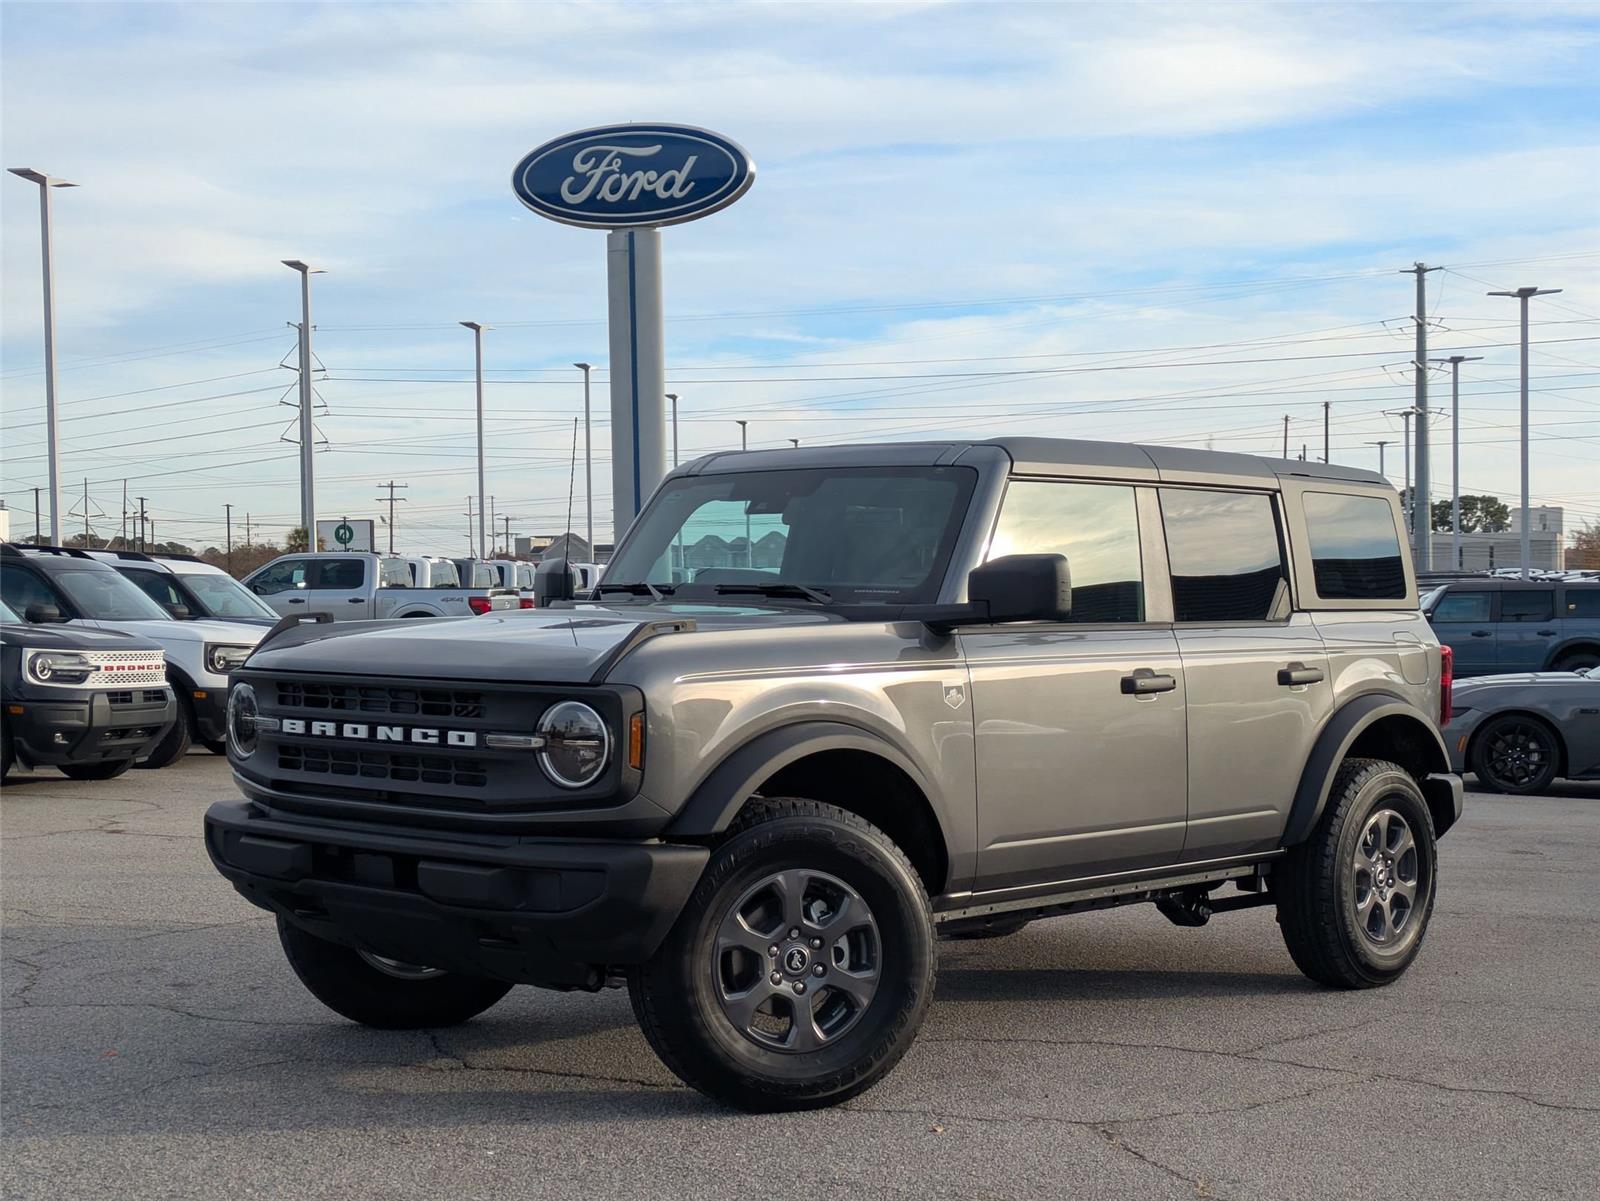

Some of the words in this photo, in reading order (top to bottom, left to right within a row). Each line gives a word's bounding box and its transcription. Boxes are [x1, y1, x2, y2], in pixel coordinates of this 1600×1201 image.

[560, 144, 698, 204] Ford
[104, 664, 161, 672] BRONCO
[281, 718, 477, 747] BRONCO
